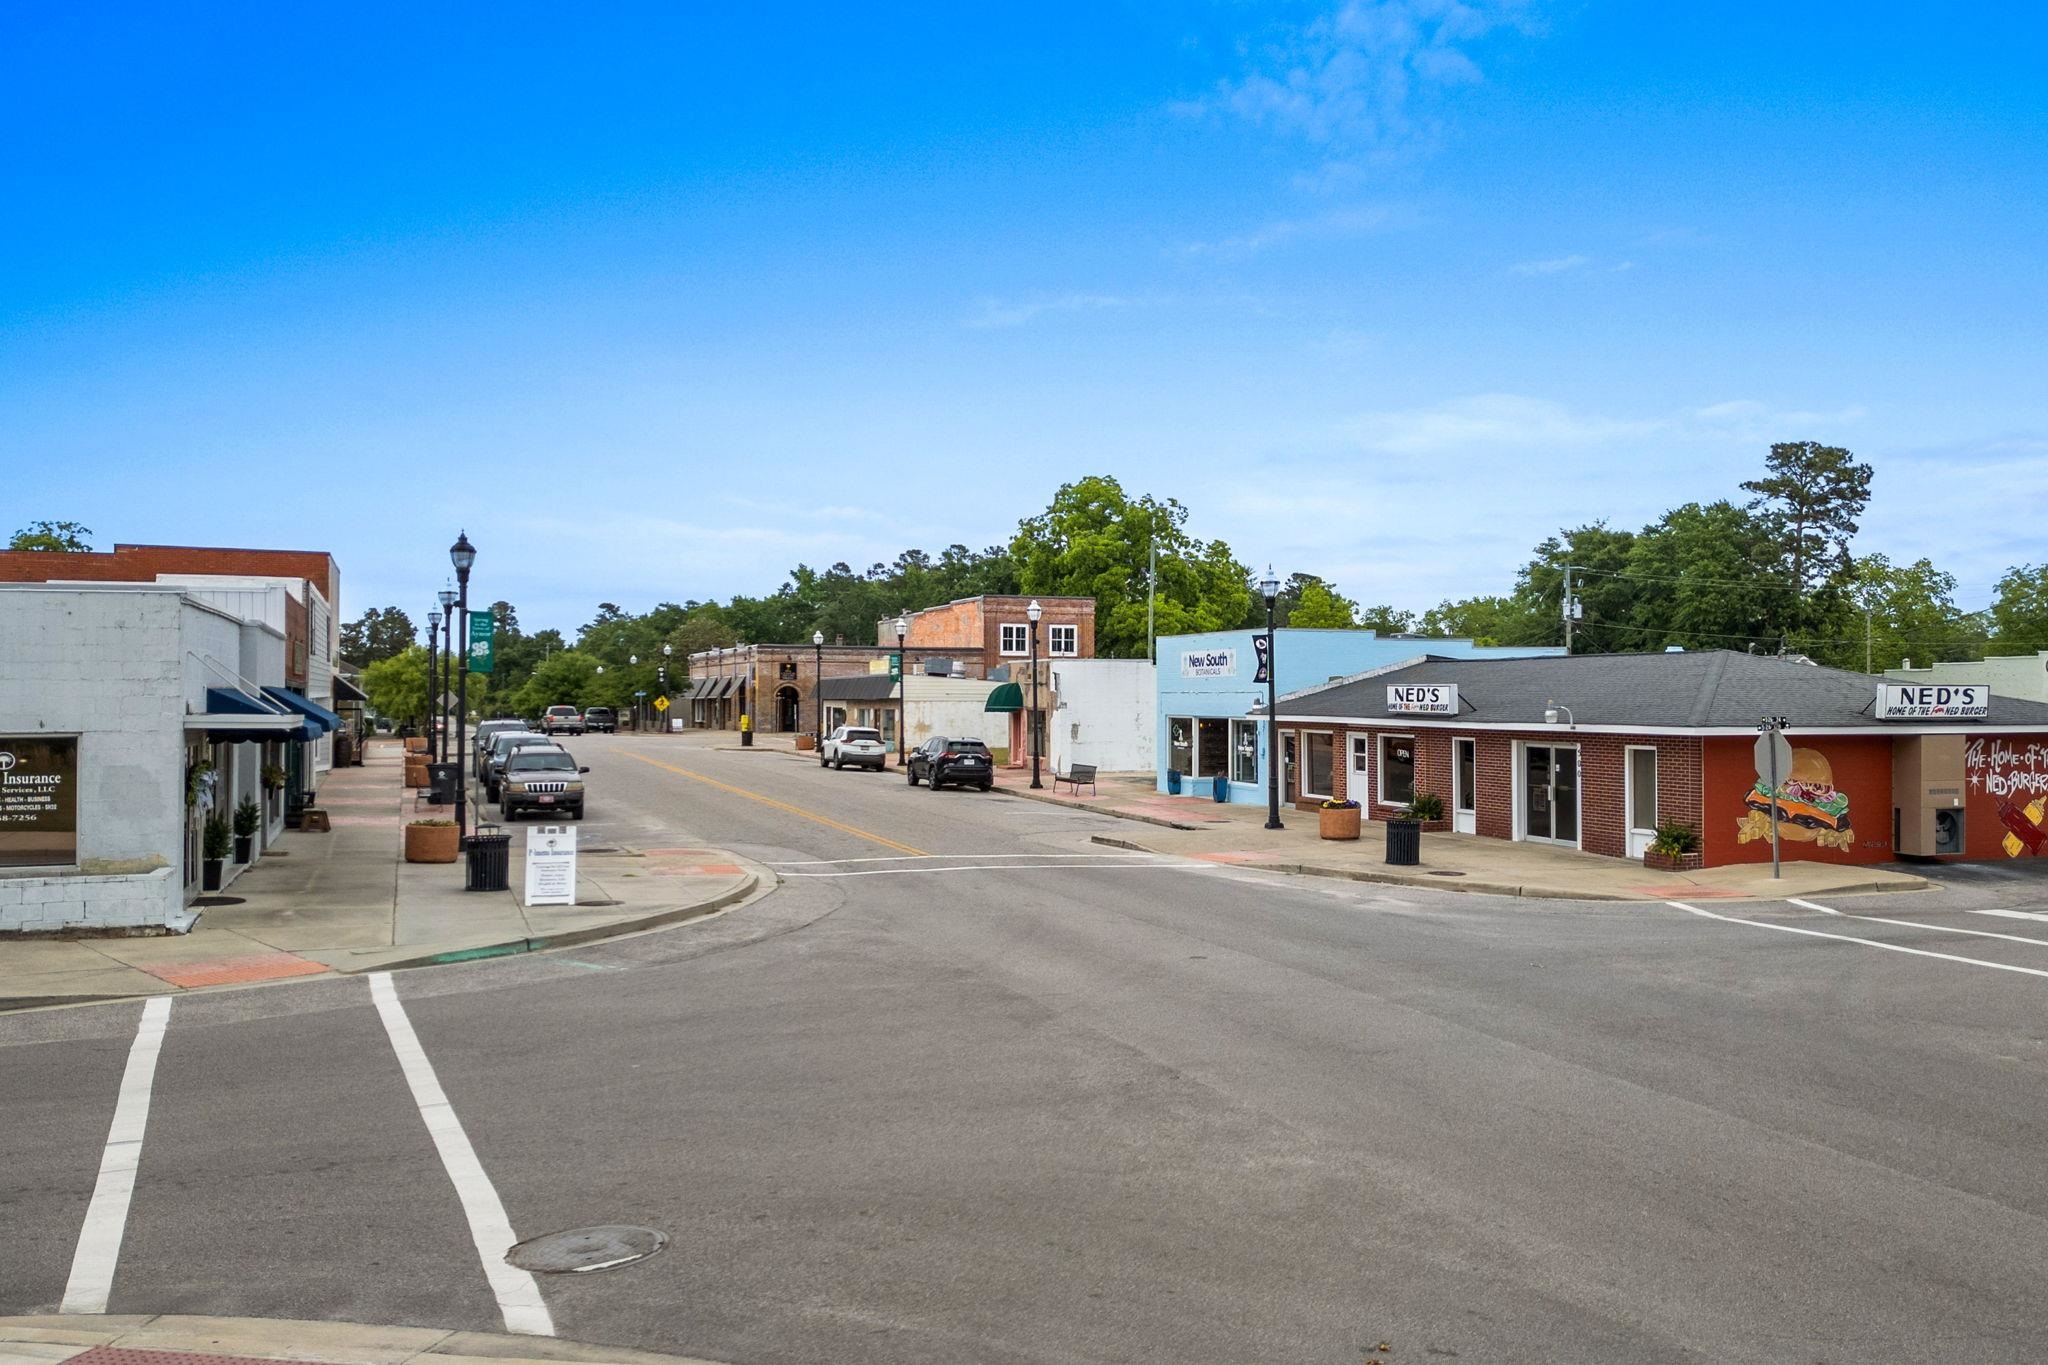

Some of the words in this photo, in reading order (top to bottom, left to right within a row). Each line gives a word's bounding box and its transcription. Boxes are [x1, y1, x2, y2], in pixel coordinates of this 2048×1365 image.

[1189, 654, 1205, 667] New
[1206, 652, 1228, 667] South
[1195, 668, 1221, 676] BOTANICALS
[1394, 687, 1440, 703] NED'S
[1900, 687, 1975, 705] NED'S
[1430, 703, 1449, 711] BURGER
[1887, 706, 1907, 715] HOME
[1908, 706, 1918, 715] OF
[1918, 706, 1931, 715] THE
[1945, 706, 1960, 715] NED
[1960, 706, 1988, 715] BURGER
[1396, 749, 1410, 758] OPEN
[3, 771, 61, 785] Insurance
[1986, 768, 2008, 796] NED
[38, 785, 56, 793] LLC
